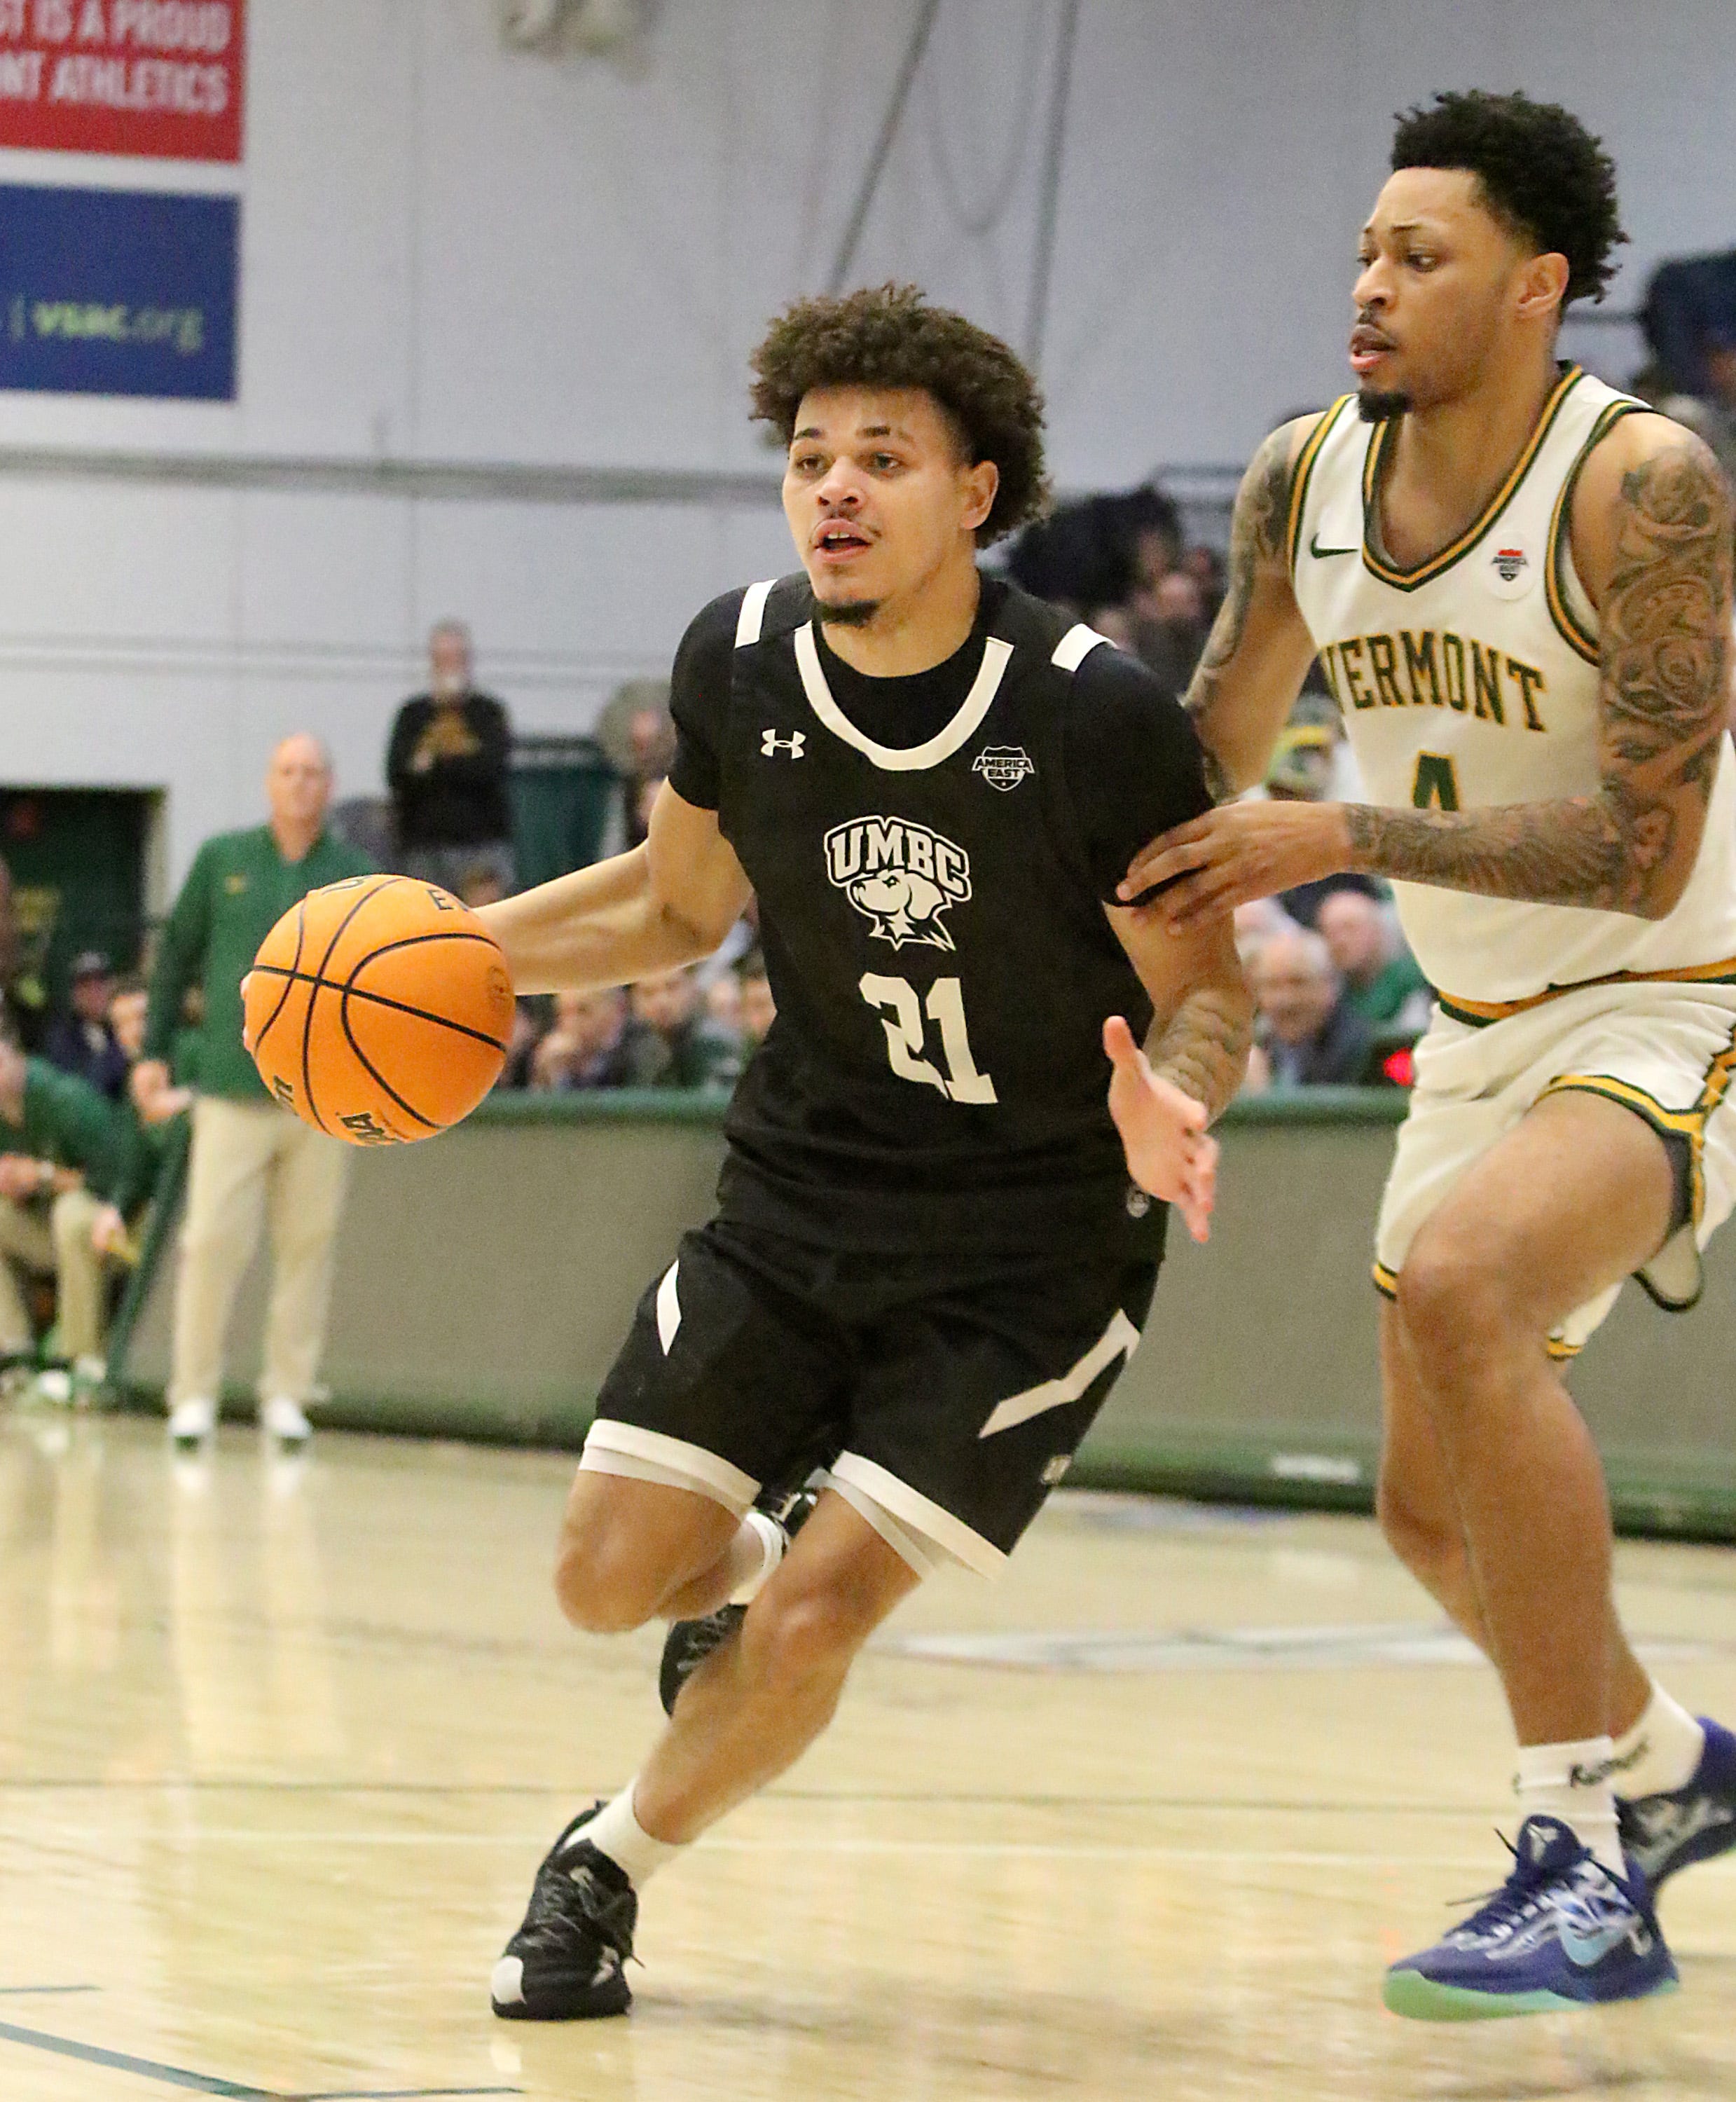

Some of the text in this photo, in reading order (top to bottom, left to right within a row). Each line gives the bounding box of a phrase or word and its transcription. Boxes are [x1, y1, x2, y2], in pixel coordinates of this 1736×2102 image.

[76, 0, 105, 43] A
[111, 0, 231, 53] PROUD
[50, 53, 229, 114] ATHLETICS
[974, 757, 1033, 772] AMERICA
[987, 768, 1019, 778] EAST
[829, 821, 967, 893] UMBC
[858, 972, 998, 1104] 21
